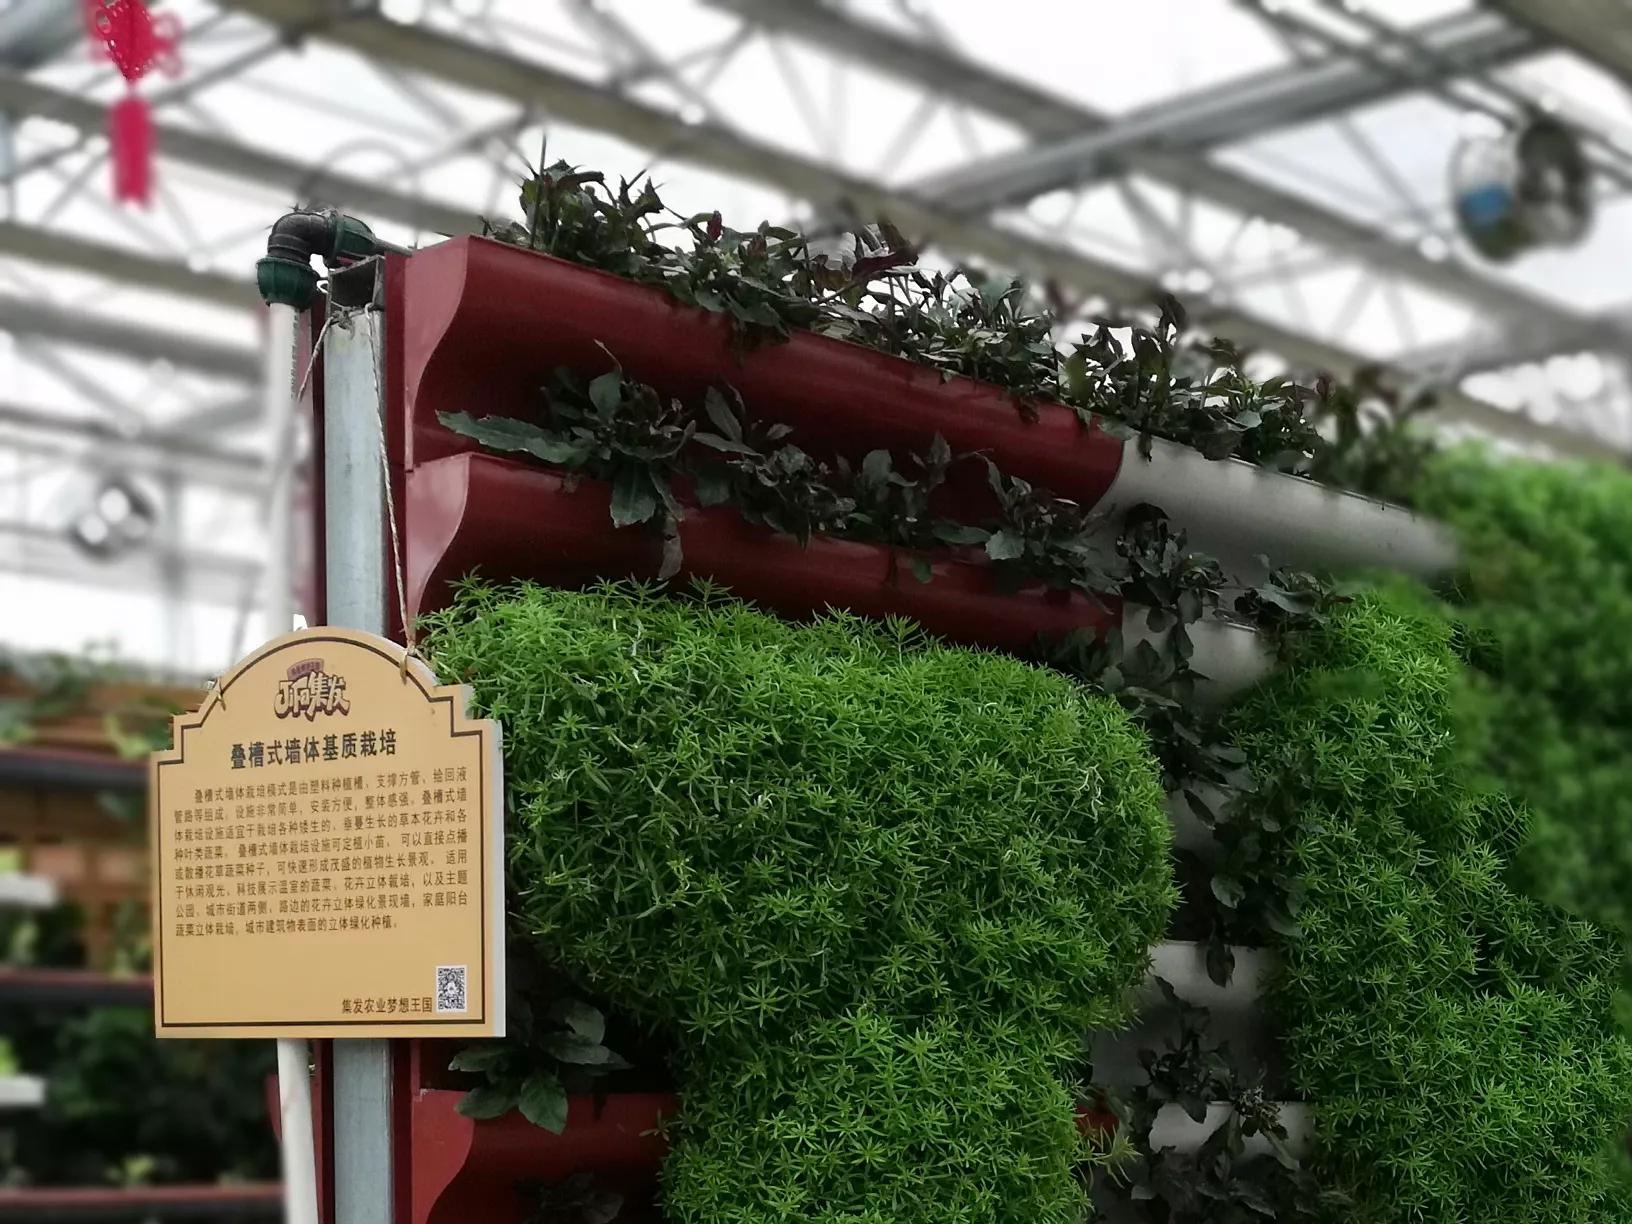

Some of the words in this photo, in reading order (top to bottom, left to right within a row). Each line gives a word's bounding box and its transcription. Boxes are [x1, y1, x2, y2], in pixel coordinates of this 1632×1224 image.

[231, 728, 397, 770] 叠槽式墙体基质栽培
[342, 996, 433, 1014] 集发农业梦想王国
